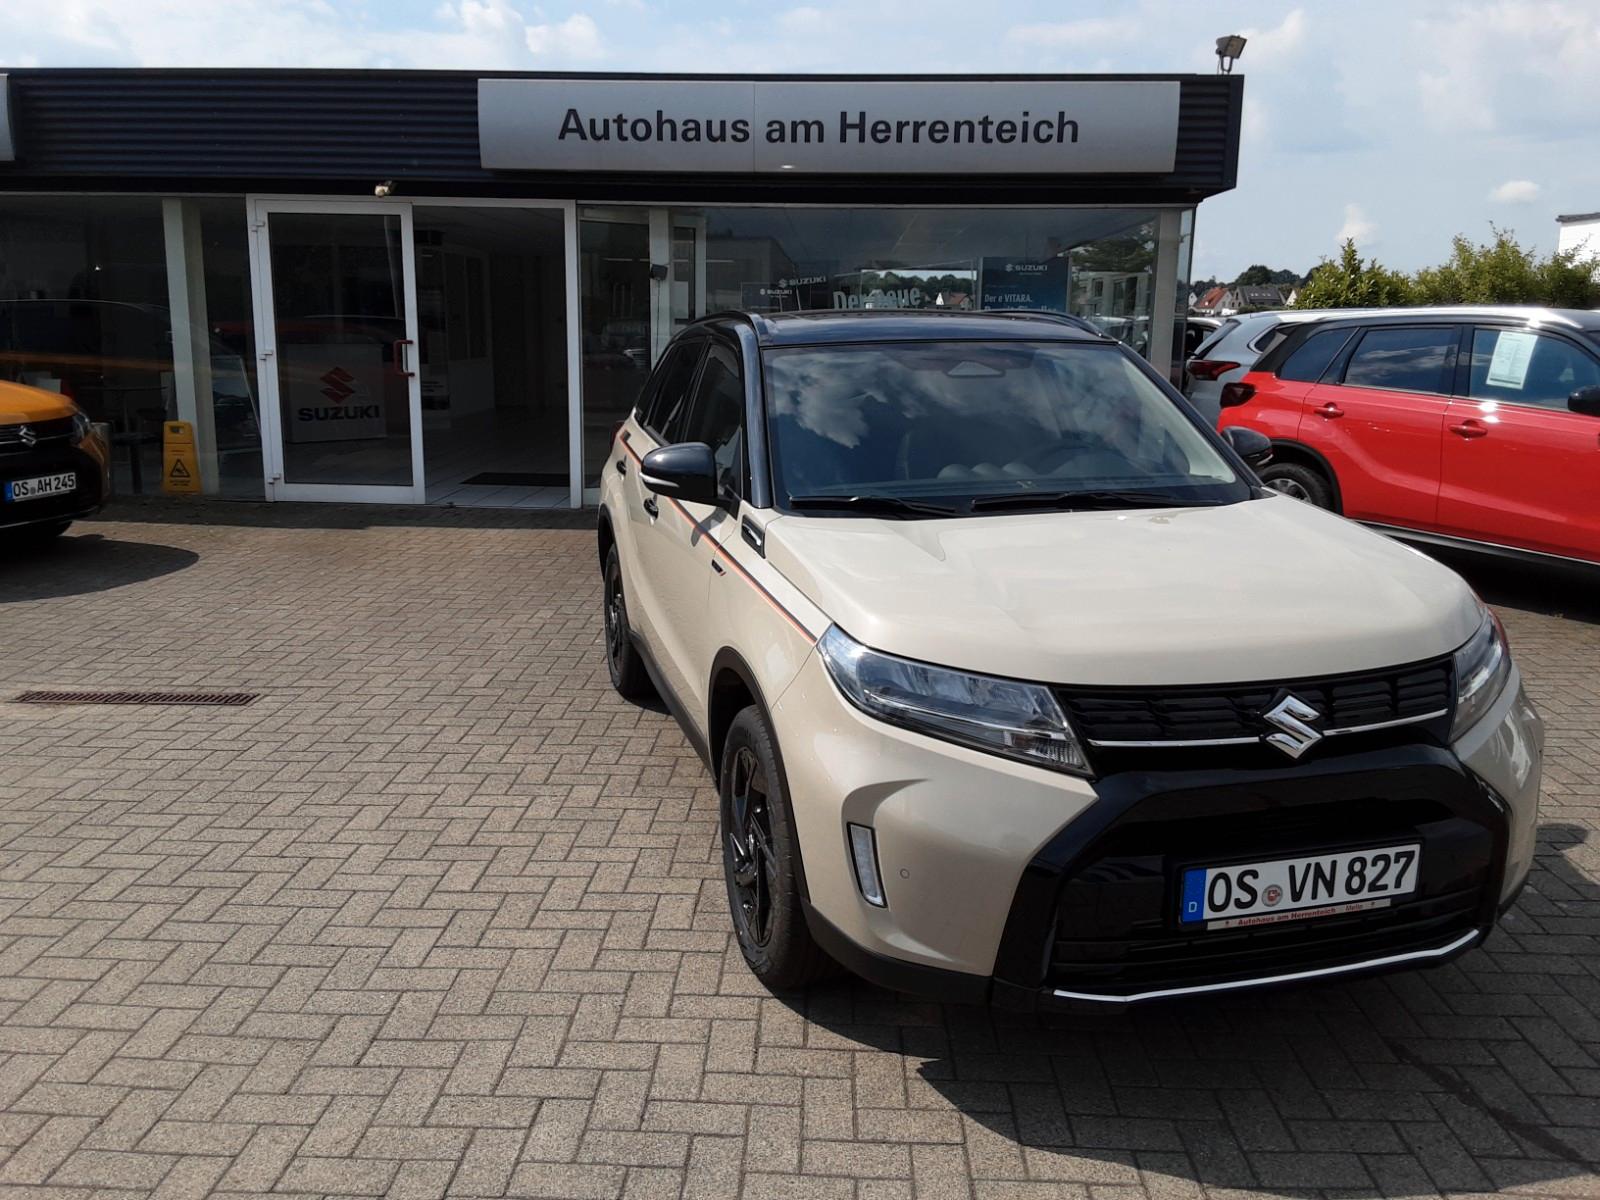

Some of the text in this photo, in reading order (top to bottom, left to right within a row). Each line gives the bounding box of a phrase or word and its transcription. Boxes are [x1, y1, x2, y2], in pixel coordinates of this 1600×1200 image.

[557, 107, 1080, 144] Autohaus am Herrenteich
[1015, 264, 1048, 272] SUZUKI
[788, 275, 827, 287] SUZUKI
[298, 404, 380, 422] SUZUKI
[13, 481, 29, 498] OS
[37, 478, 52, 494] AH
[54, 474, 75, 491] 245
[1207, 850, 1416, 913] OS VN 827
[1187, 901, 1198, 913] D
[1238, 914, 1275, 926] Autohaus
[1277, 913, 1290, 922] am
[1291, 906, 1337, 921] Herrenteich
